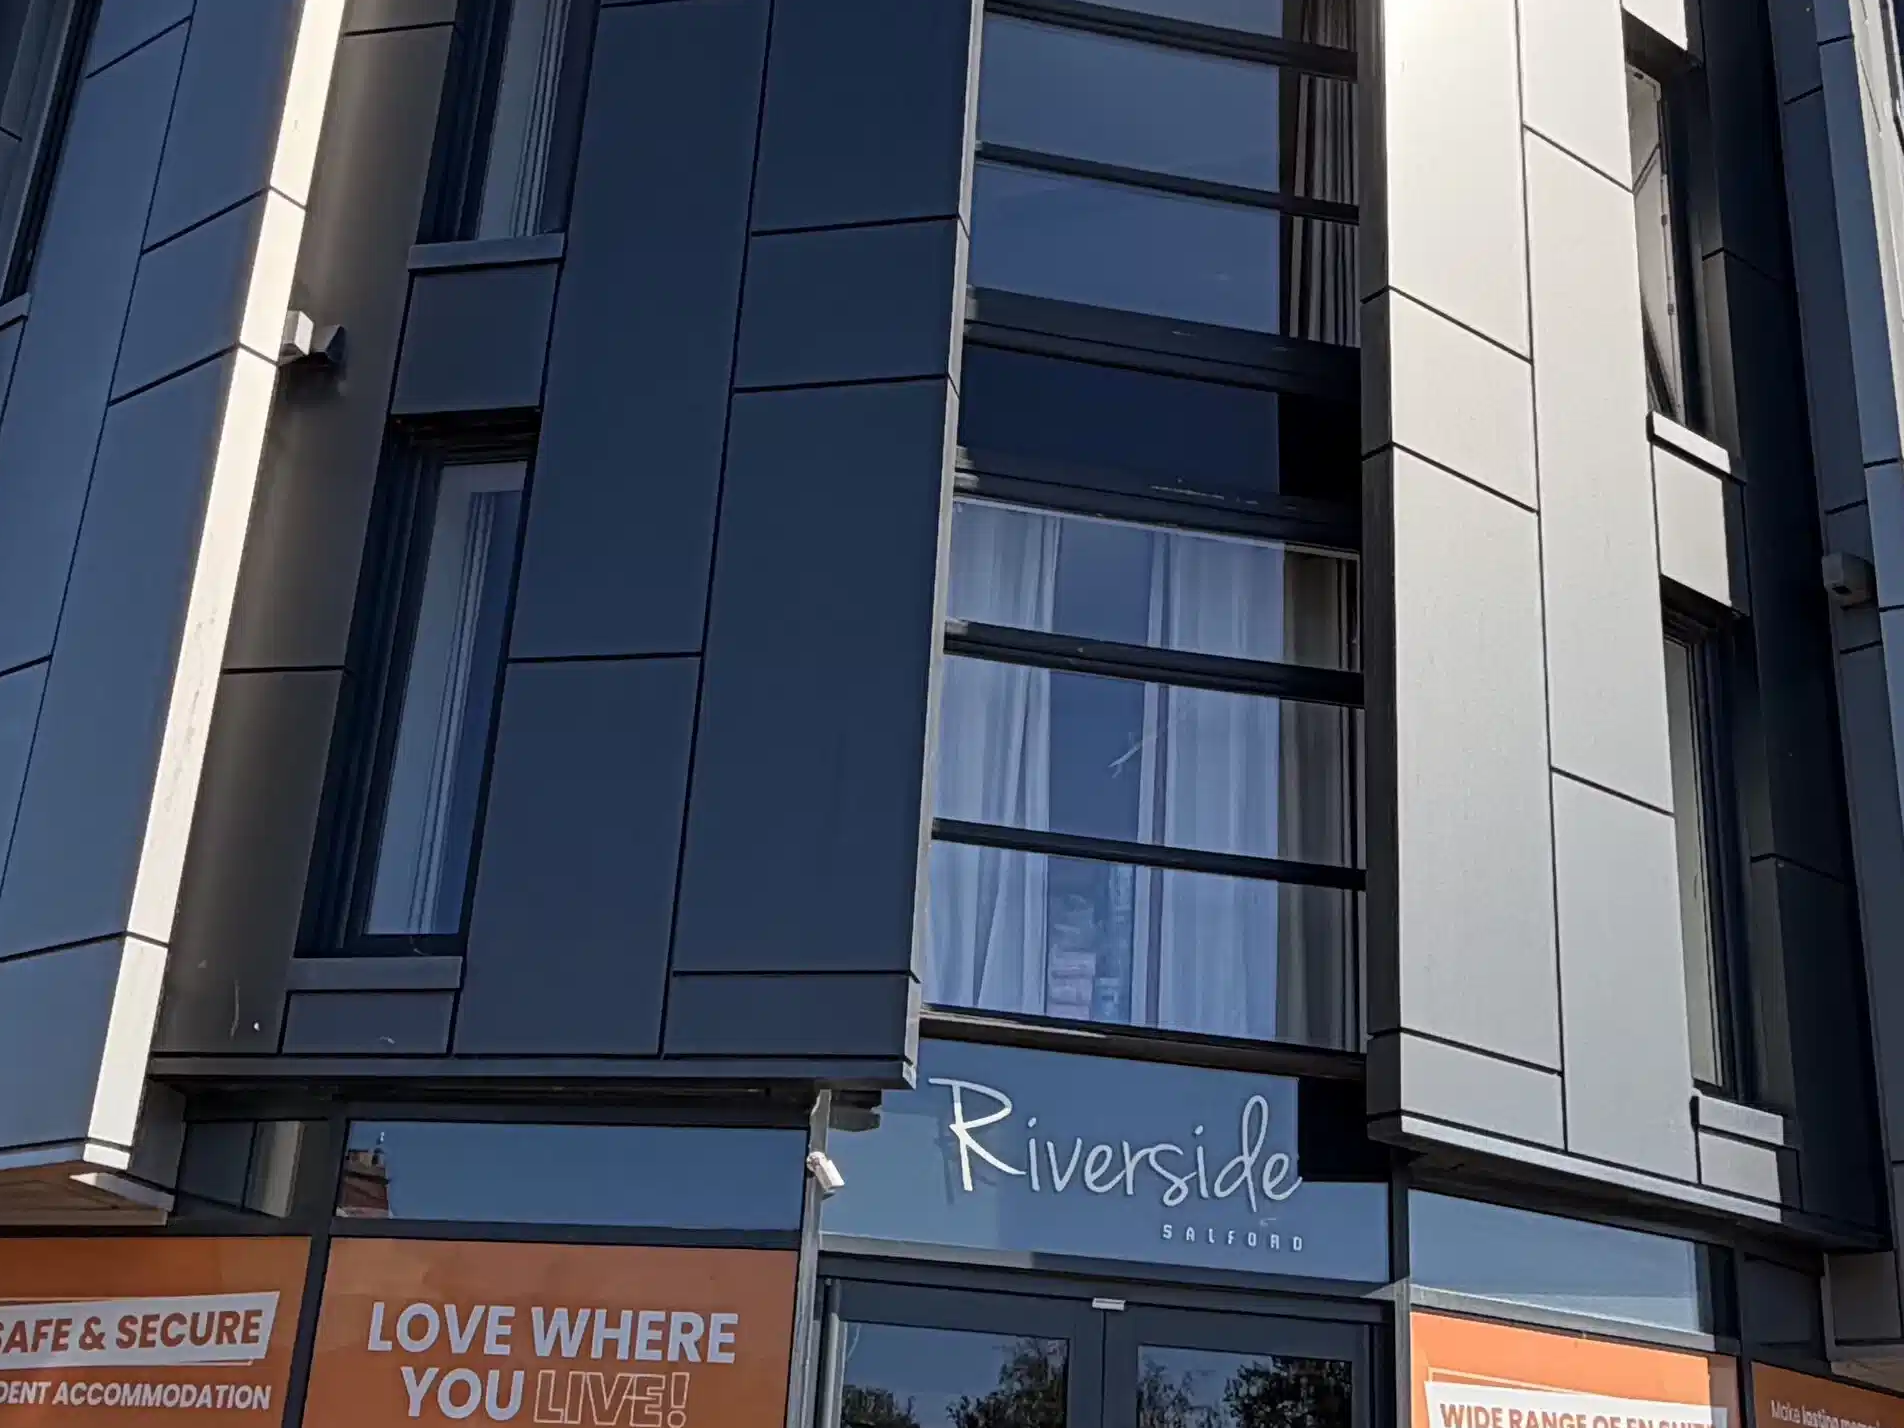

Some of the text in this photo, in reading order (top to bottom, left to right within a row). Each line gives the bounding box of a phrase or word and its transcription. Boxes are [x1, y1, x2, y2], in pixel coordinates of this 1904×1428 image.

[928, 1076, 1303, 1213] Riverside
[1160, 1224, 1304, 1252] SALFORD
[77, 1315, 107, 1351] &
[114, 1308, 263, 1350] SECURE
[367, 1300, 739, 1365] LOVE WHERE
[52, 1380, 272, 1410] ACCOMMODATION
[399, 1365, 691, 1428] YOU LIVE!
[1770, 1399, 1801, 1424] Make
